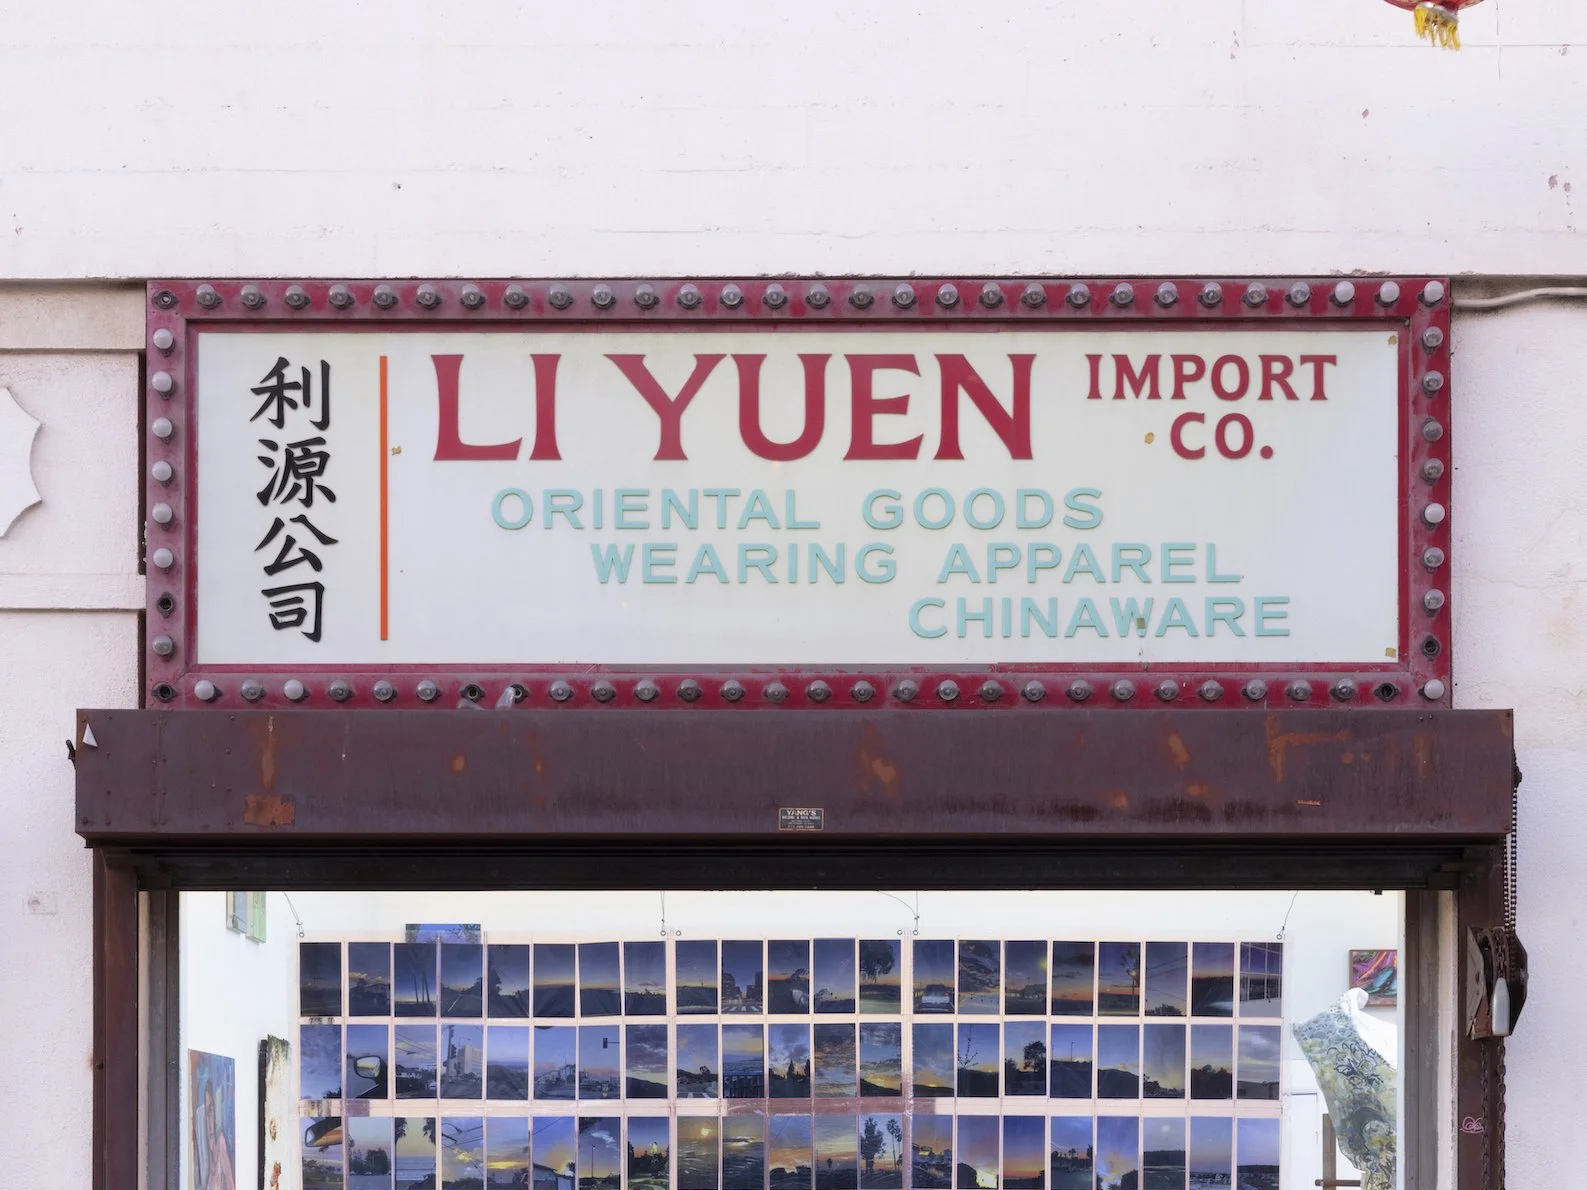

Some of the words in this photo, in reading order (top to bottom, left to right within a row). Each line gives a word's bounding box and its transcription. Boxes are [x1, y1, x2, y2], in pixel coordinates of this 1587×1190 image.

[1085, 353, 1338, 401] IMPORT
[430, 353, 563, 462] LI
[603, 353, 1037, 462] YUEN
[1169, 411, 1274, 461] CO.
[249, 356, 339, 643] 利源公司
[490, 486, 821, 531] ORIENTAL
[862, 486, 1103, 531] GOODS
[590, 542, 897, 585] WEARING
[937, 542, 1243, 585] APPAREL
[908, 596, 1292, 639] CHINAWARE
